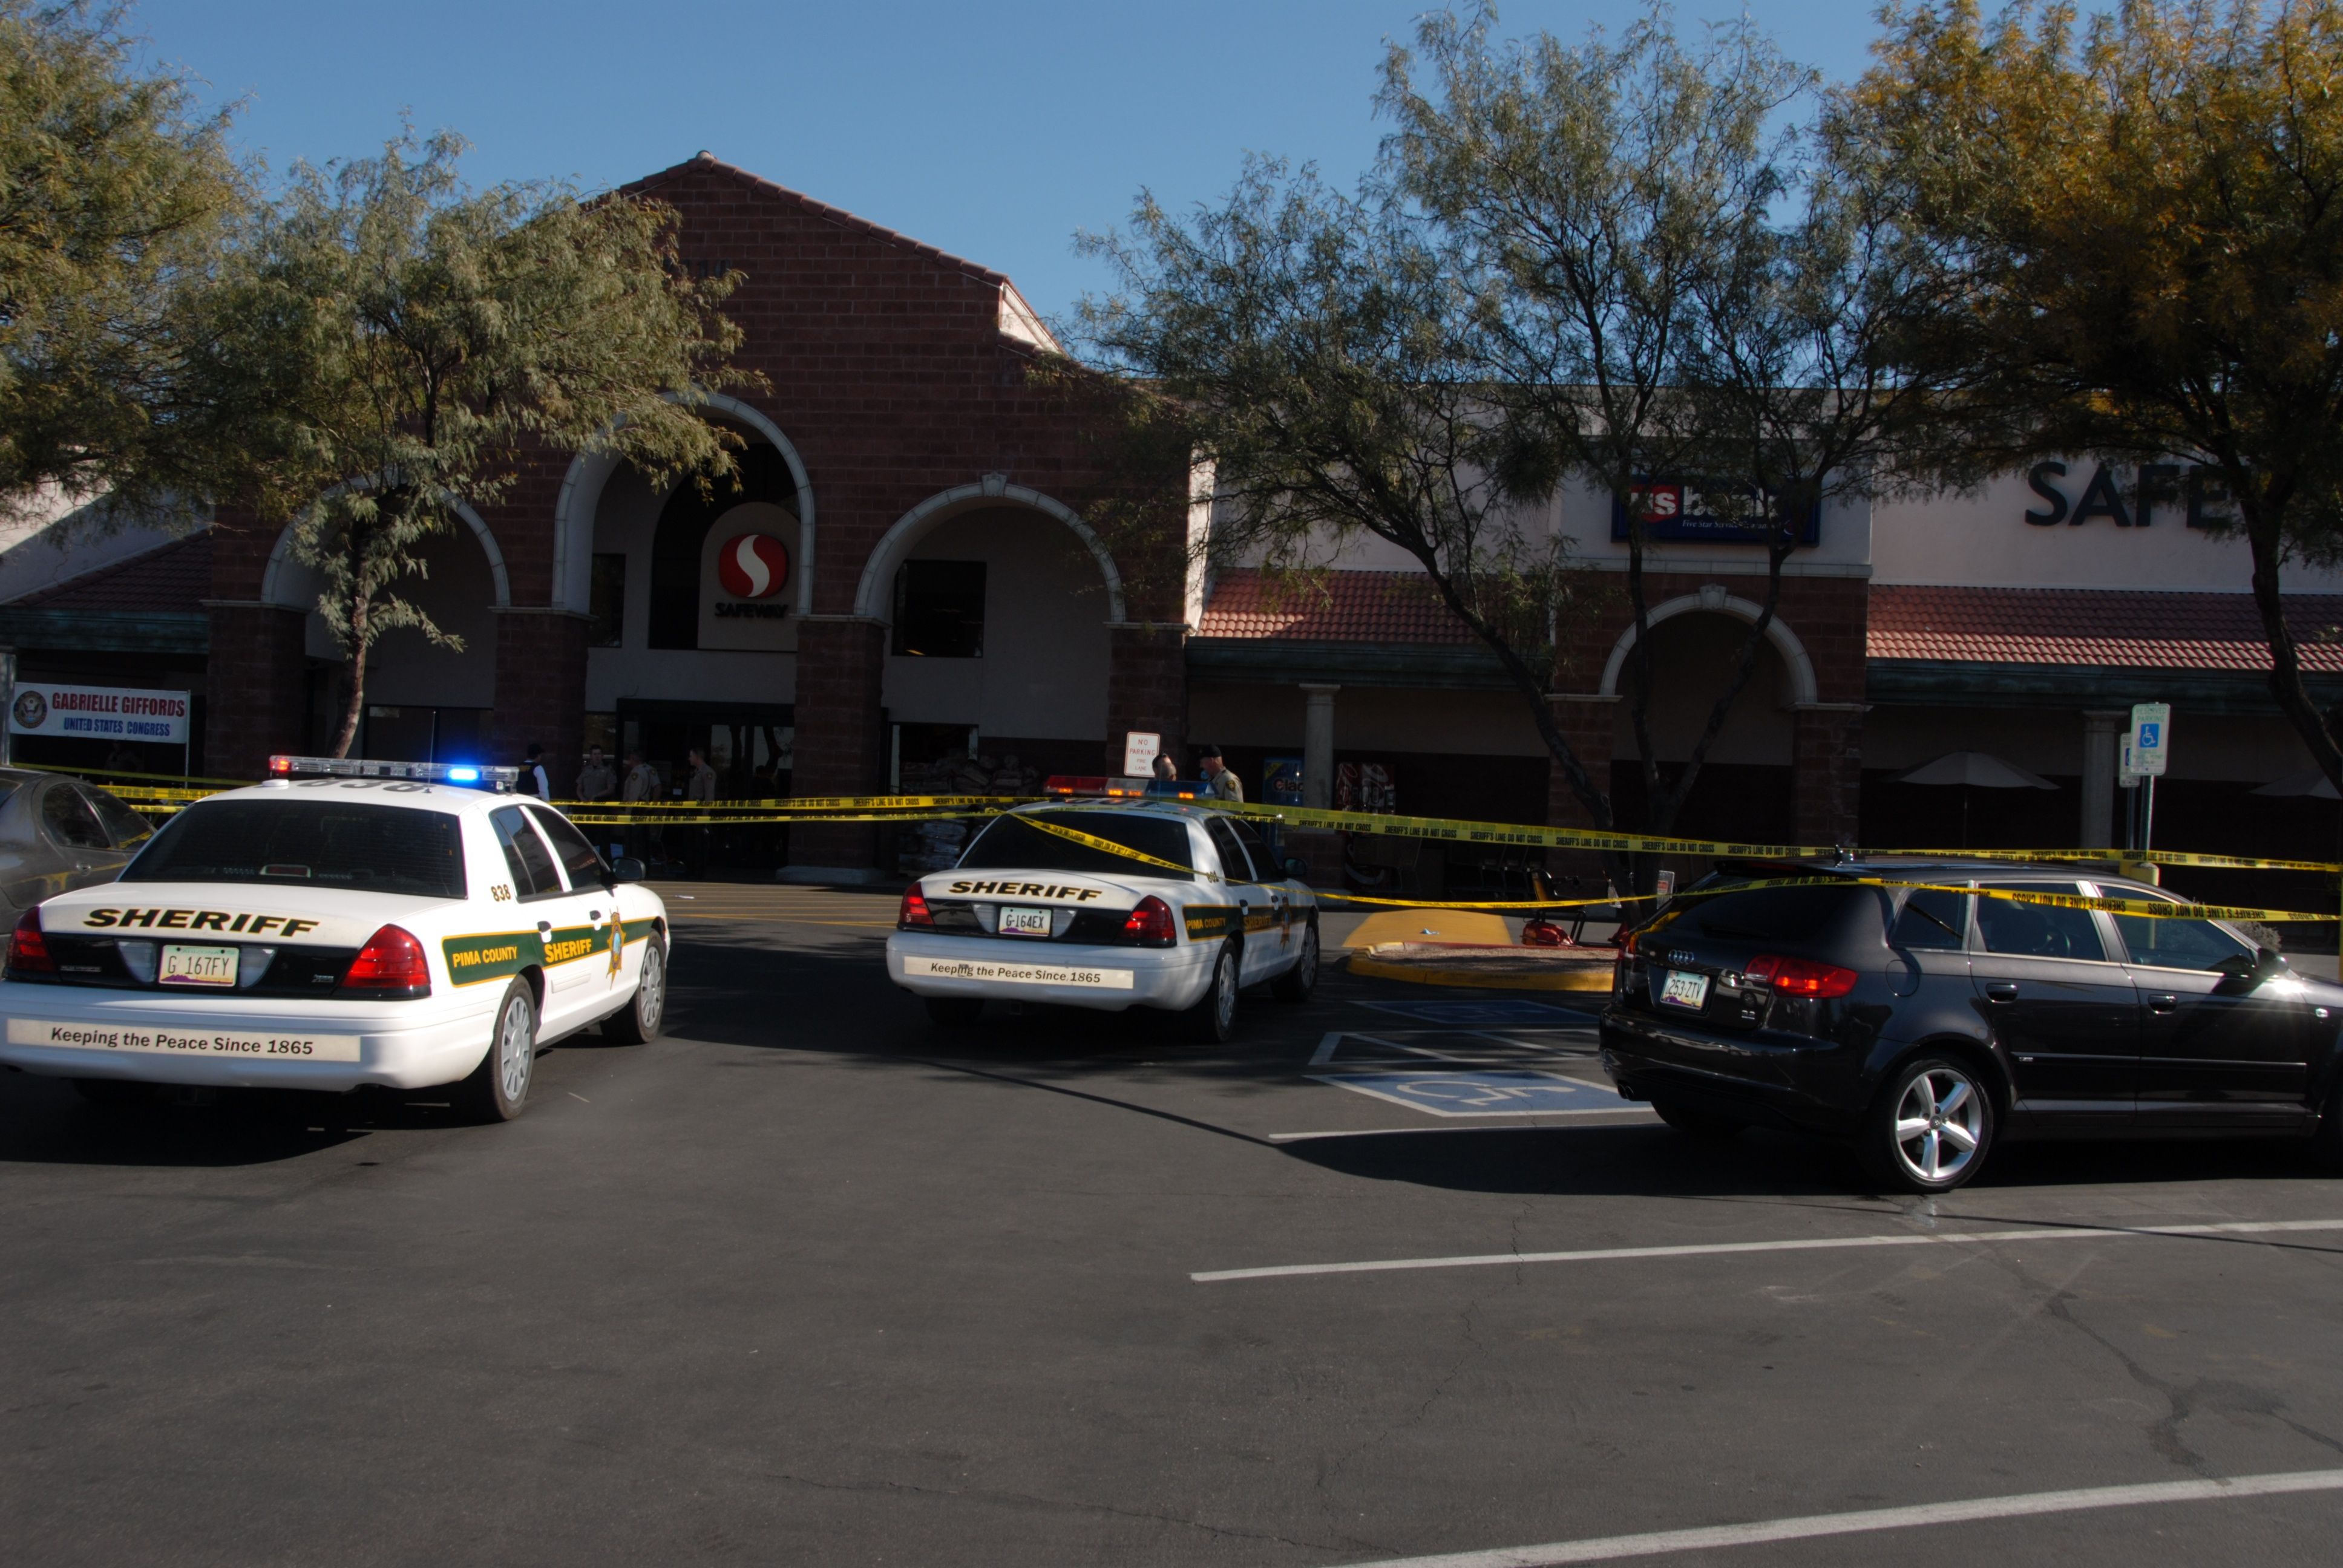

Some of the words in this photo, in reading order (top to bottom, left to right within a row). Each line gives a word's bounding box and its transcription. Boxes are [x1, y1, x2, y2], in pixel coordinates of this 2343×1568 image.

[715, 603, 788, 618] SAFEWAY
[53, 693, 118, 713] GABRIELLE
[122, 696, 185, 717] GIFFORDS
[64, 717, 92, 731] UNITED
[94, 719, 123, 733] STATES
[127, 722, 170, 736] CONGRESS
[775, 799, 796, 807] SHERIFF'S
[798, 799, 807, 807] LINE
[853, 798, 875, 806] SHERIFF'S
[876, 798, 886, 806] LINE
[1299, 819, 1322, 828] SHERIFF'S
[1384, 825, 1407, 834] SHERIFF'S
[1409, 827, 1420, 835] LINE
[1422, 828, 1429, 836] DO
[1430, 828, 1440, 837] NOT
[1441, 829, 1457, 838] CROSS
[1470, 831, 1493, 841] SHERIFF'S
[1495, 832, 1506, 841] LINE
[1507, 834, 1514, 842] DO
[1516, 834, 1525, 843] NOT
[1527, 835, 1542, 843] CROSS
[1556, 837, 1579, 846] SHERIFF'S
[1602, 839, 1611, 848] NOT
[1613, 840, 1628, 848] CROSS
[1642, 841, 1665, 851] SHERIFF'S
[1679, 843, 1686, 851] DO
[1688, 843, 1697, 852] NOT
[1699, 844, 1714, 852] CROSS
[1728, 846, 1751, 855] SHERIFF'S
[1753, 846, 1763, 855] LINE
[1766, 846, 1772, 855] DO
[1774, 847, 1783, 856] NOT
[1786, 848, 1801, 857] CROSS
[2122, 852, 2147, 860] SHERIFF'S
[491, 884, 511, 901] 838
[949, 881, 1102, 901] SHERIFF
[2012, 893, 2036, 902] CROSS
[2039, 893, 2053, 905] NOT
[2056, 895, 2066, 906] DO
[2069, 897, 2086, 909] LINE
[2089, 898, 2126, 912] SHERIFF'S
[2148, 903, 2173, 913] CROSS
[2176, 906, 2191, 916] NOT
[2194, 907, 2204, 917] DO
[2207, 907, 2224, 918] LINE
[2228, 909, 2266, 919] SHERIFF'S
[83, 908, 321, 937] SHERIFF
[1186, 919, 1204, 929] PIMA
[1204, 916, 1227, 929] COUNTY
[1243, 915, 1272, 929] SHERIFF
[453, 951, 481, 967] PIMA
[482, 946, 517, 963] COUNTY
[545, 939, 592, 963] SHERIFF
[168, 955, 177, 973] G
[185, 956, 229, 976] 167FY
[931, 962, 974, 976] Keeping
[977, 967, 994, 976] the
[998, 968, 1032, 979] Peace
[1035, 970, 1066, 981] Since
[1070, 972, 1101, 983] 1865
[51, 1027, 118, 1048] Keeping
[123, 1033, 150, 1047] the
[156, 1034, 208, 1050] Peace
[214, 1037, 261, 1053] Since
[267, 1040, 313, 1055] 1865
